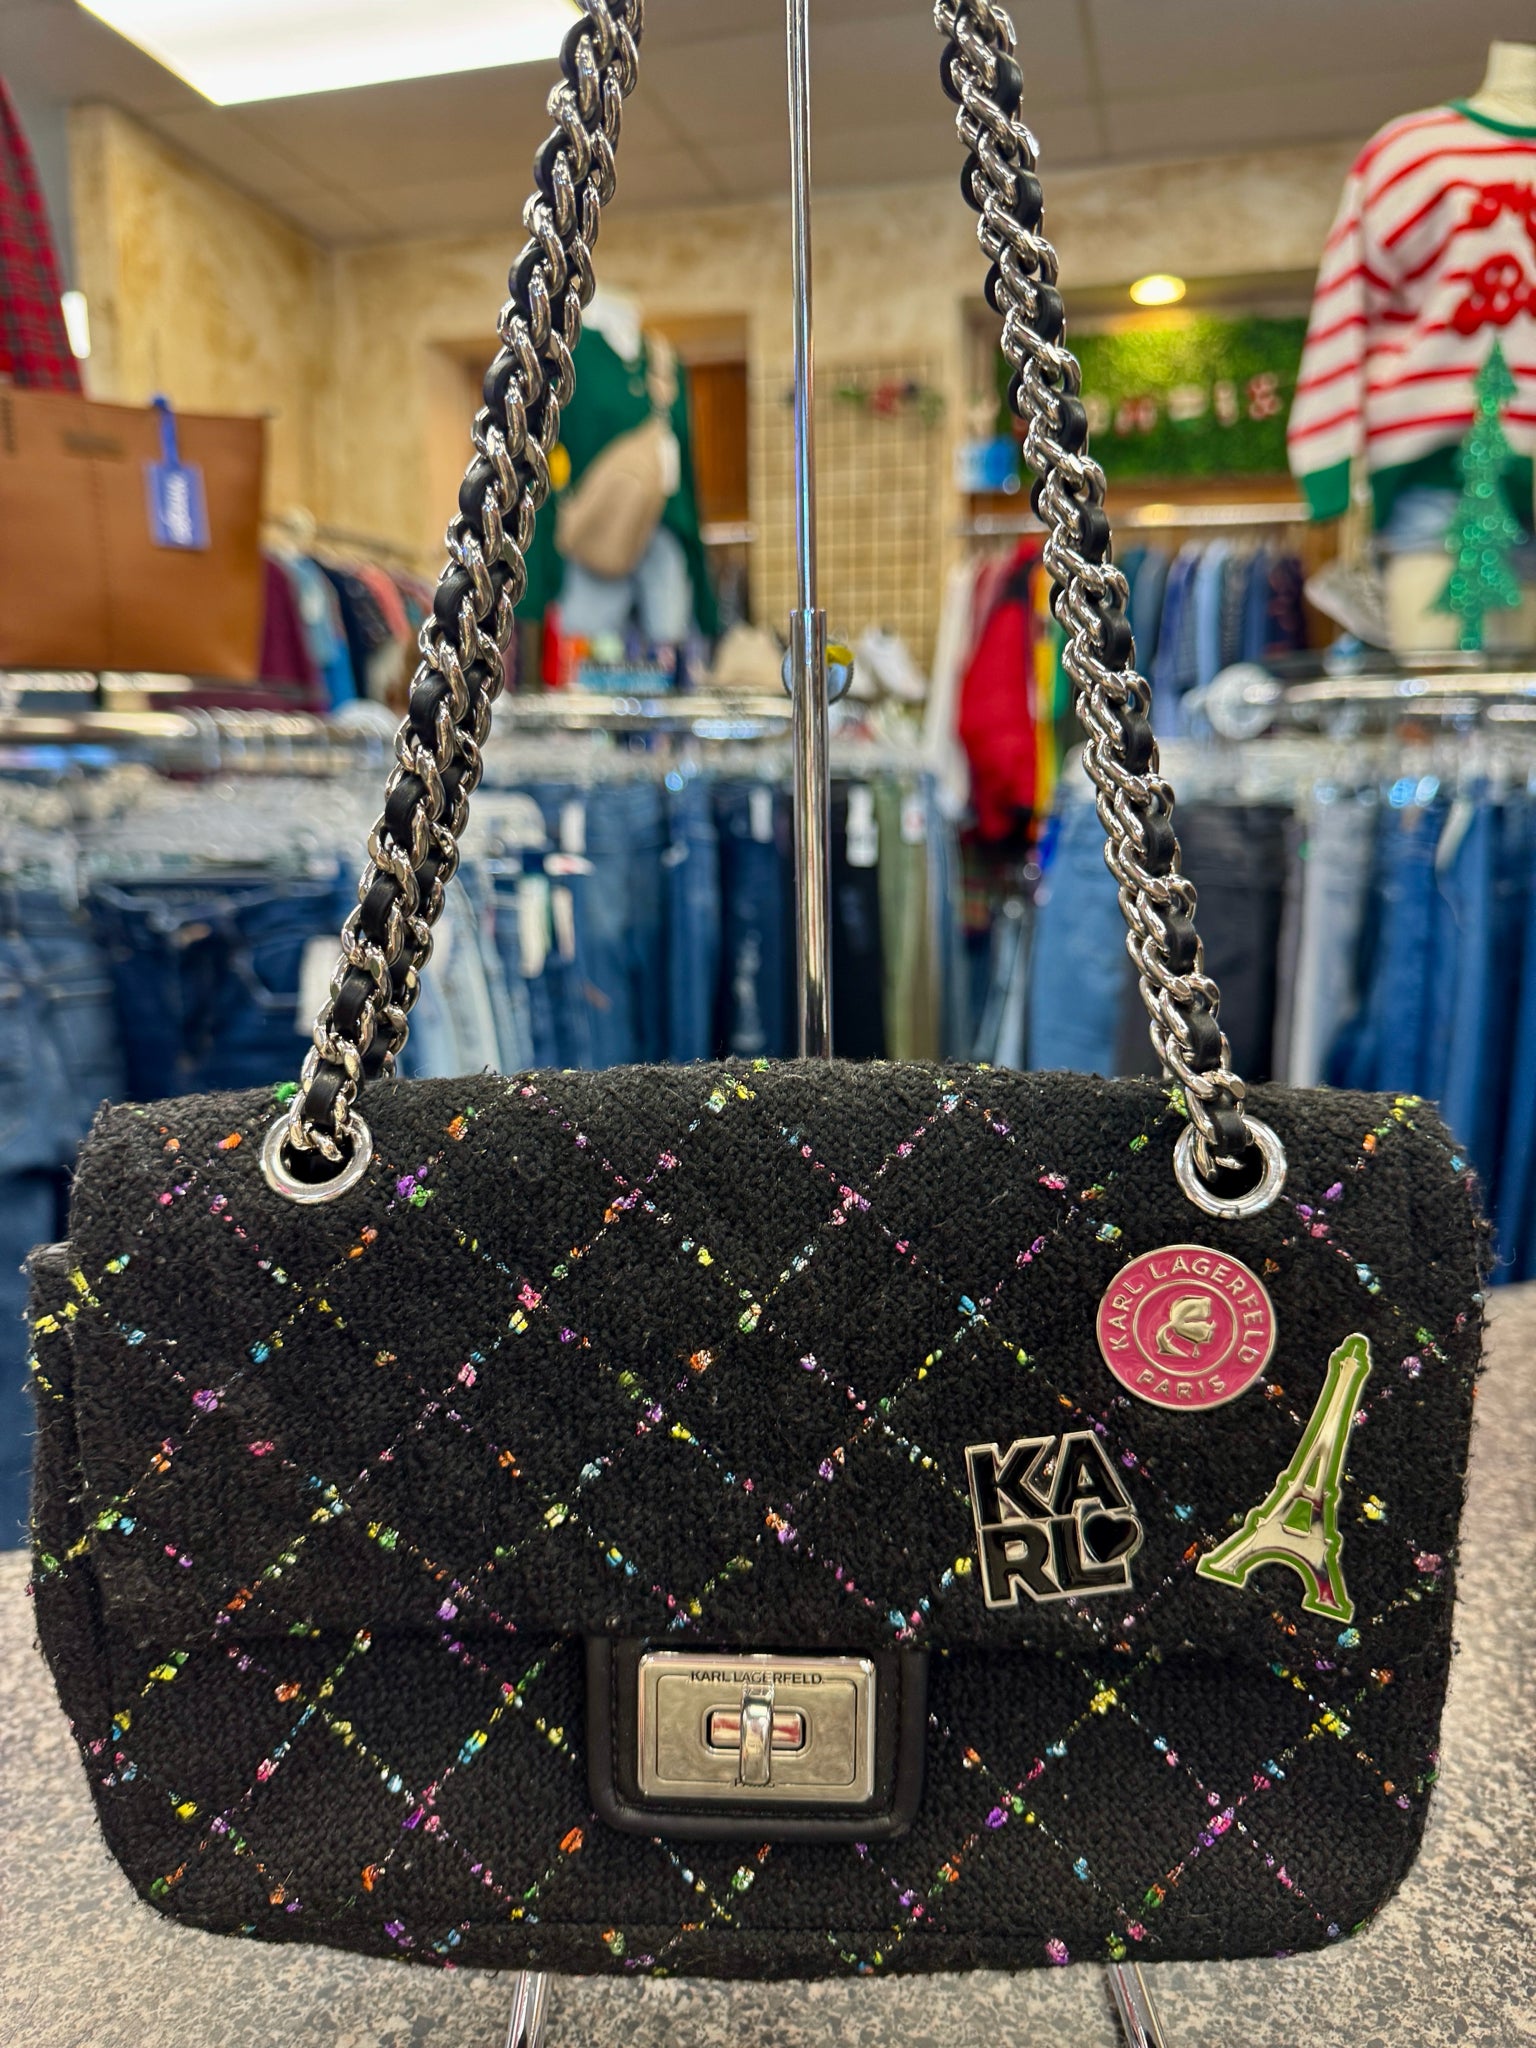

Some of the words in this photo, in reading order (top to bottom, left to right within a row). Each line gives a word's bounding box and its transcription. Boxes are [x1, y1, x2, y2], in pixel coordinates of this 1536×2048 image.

[1108, 1280, 1144, 1350] KARL
[1150, 1256, 1264, 1365] LAGERFELD
[1136, 1369, 1227, 1400] PARIS
[690, 1670, 731, 1683] KARL
[732, 1671, 823, 1685] LAGERFELD
